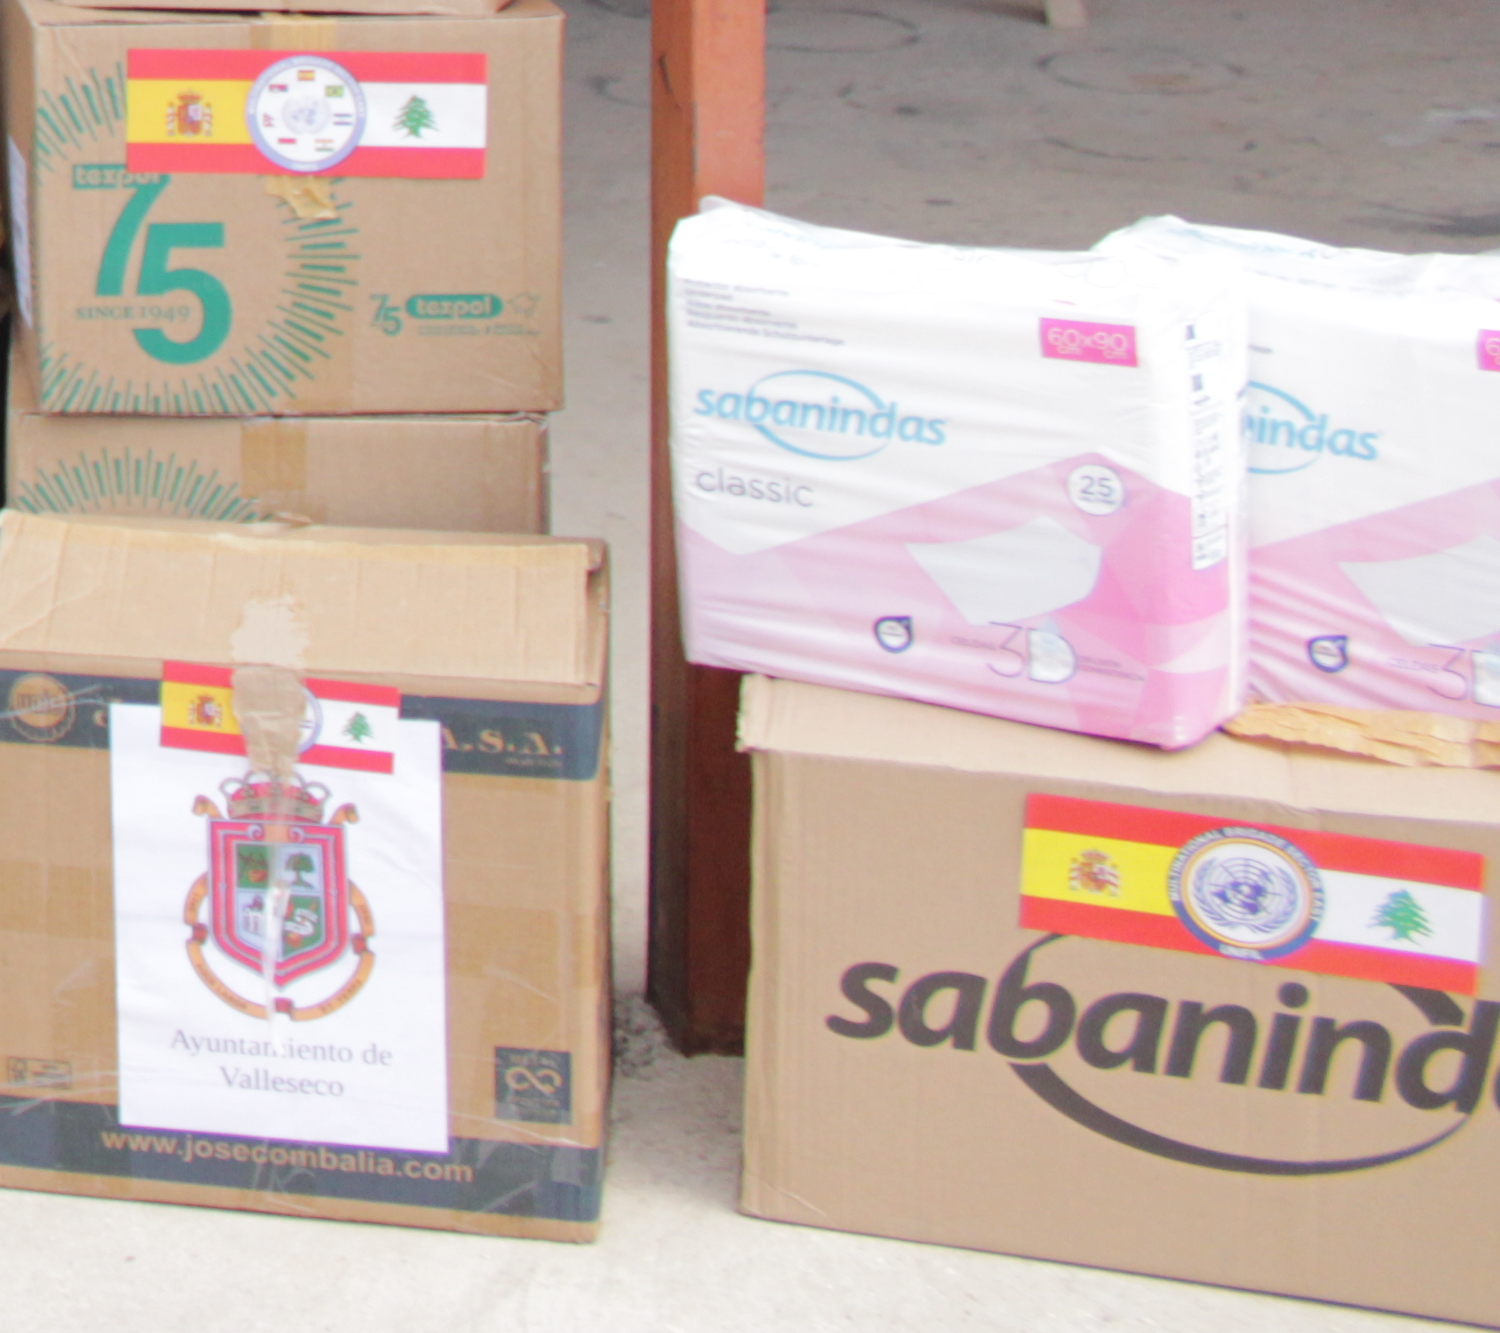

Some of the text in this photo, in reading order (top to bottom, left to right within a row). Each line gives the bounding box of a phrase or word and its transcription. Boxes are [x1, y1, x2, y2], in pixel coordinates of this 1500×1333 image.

[94, 173, 234, 367] 75
[75, 304, 193, 323] SINCE 1949
[368, 293, 403, 337] 75
[416, 296, 494, 319] texpol
[693, 382, 948, 447] sabanindas
[695, 467, 815, 509] classic
[1078, 474, 1114, 499] 25
[826, 943, 1500, 1115] sabanind
[361, 1041, 393, 1067] de
[217, 1064, 345, 1099] Valleseco
[101, 1131, 474, 1185] www.josecombalia.com
